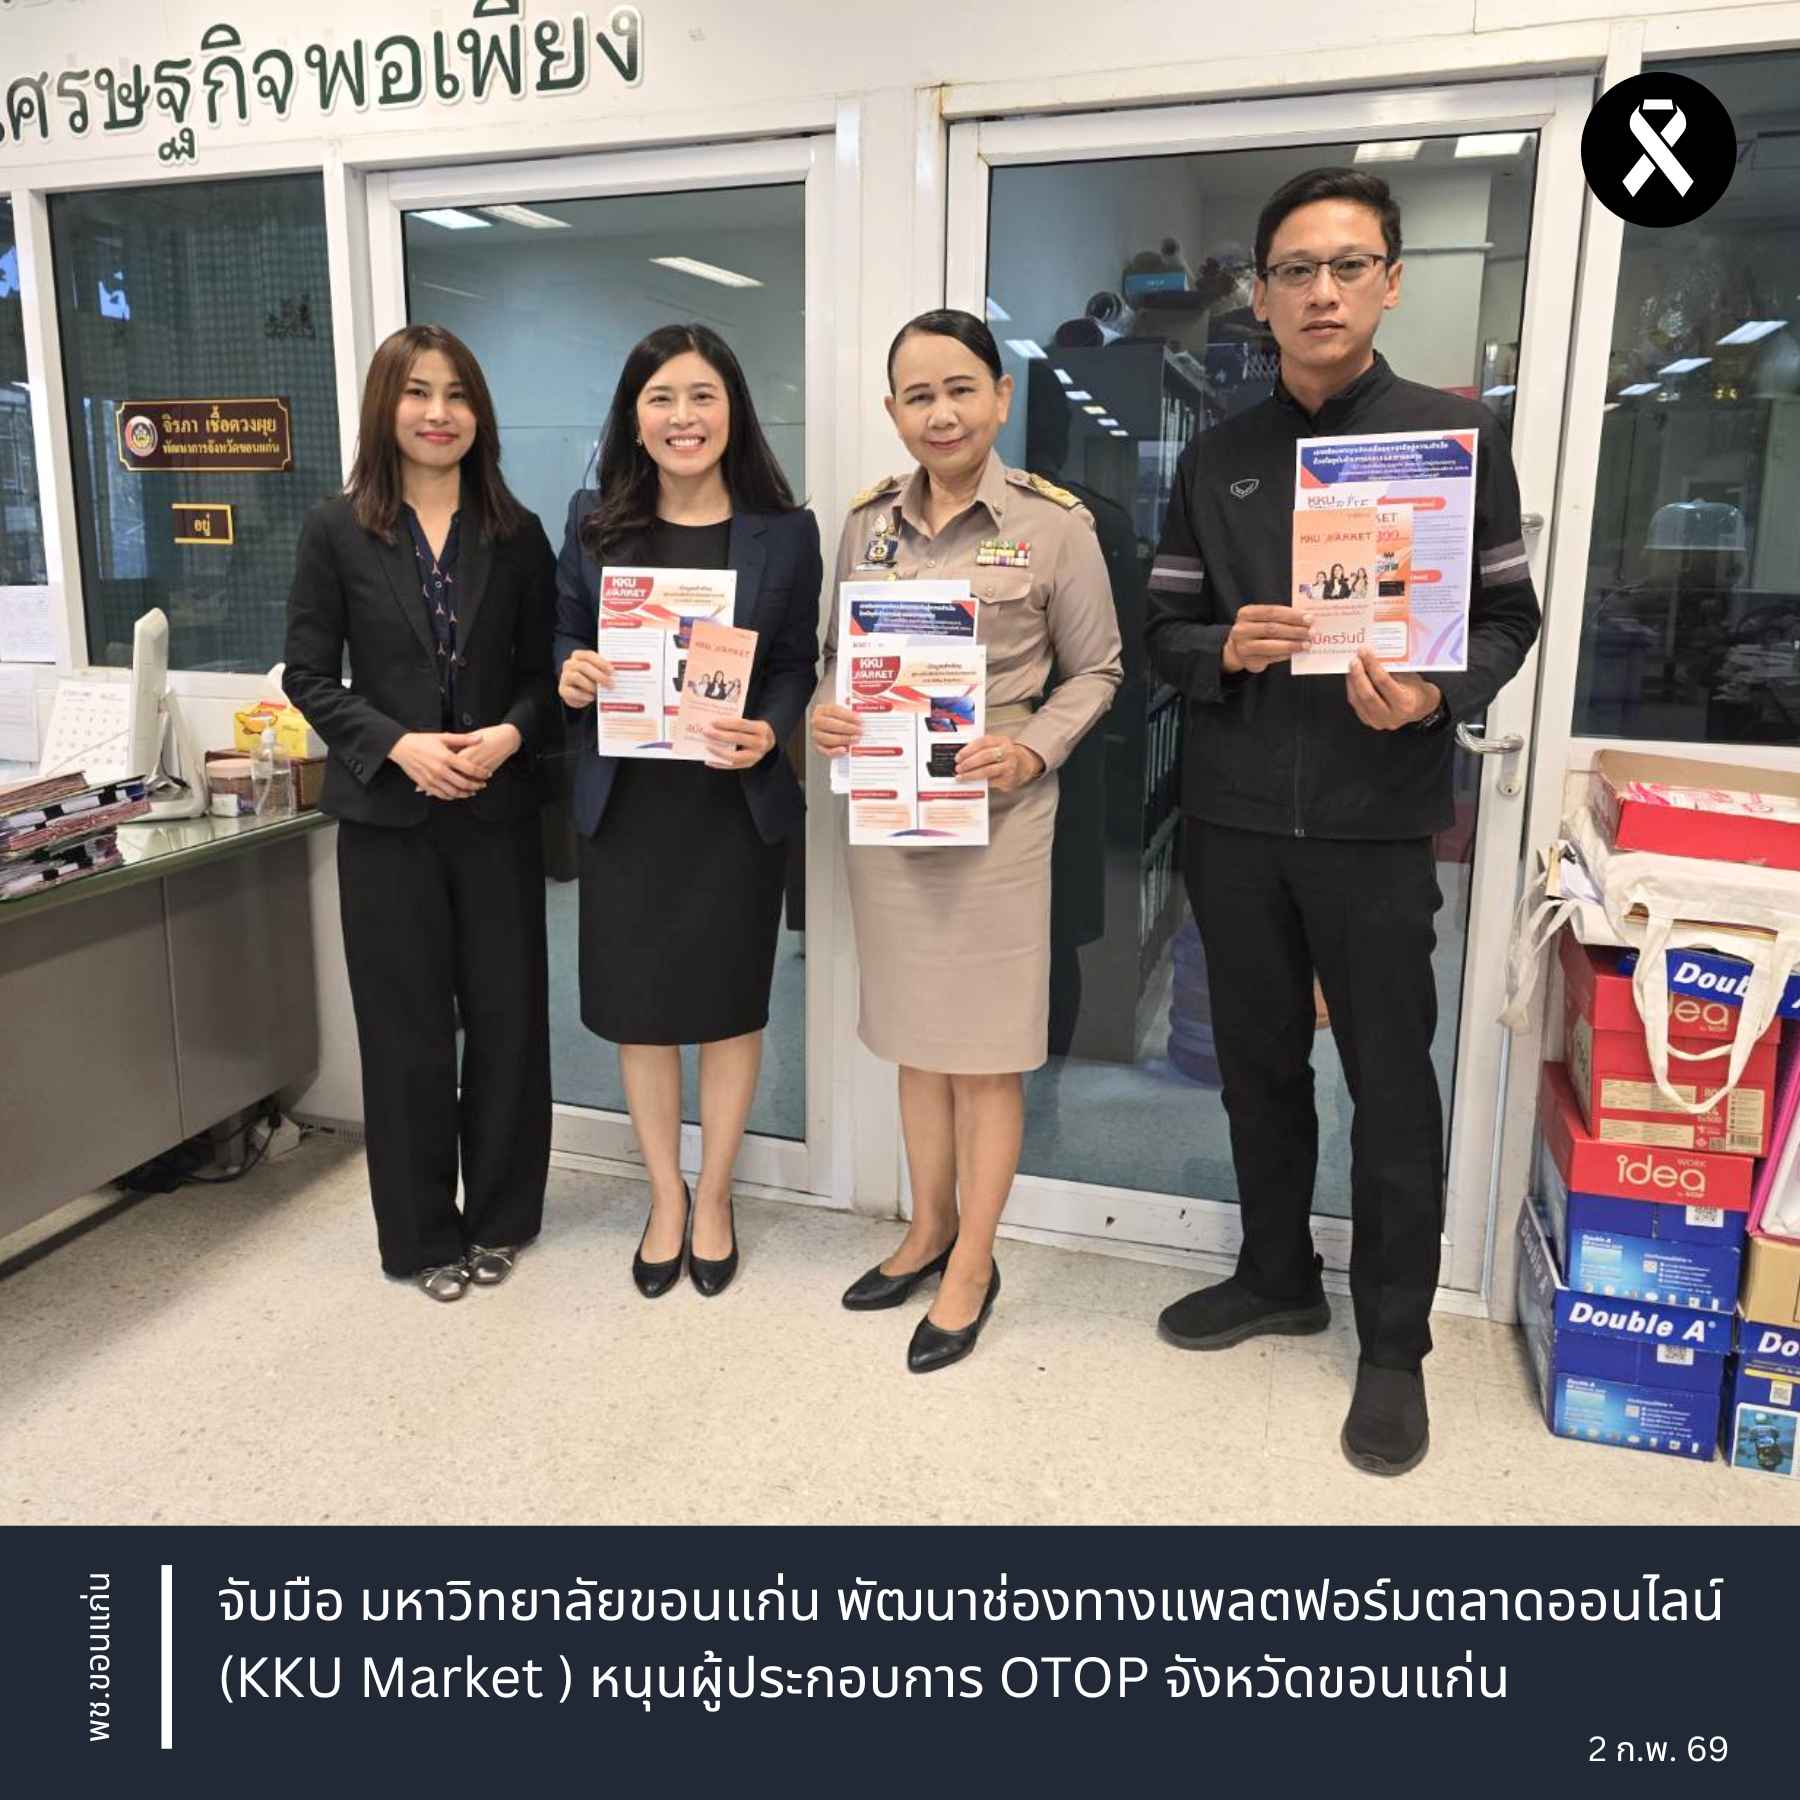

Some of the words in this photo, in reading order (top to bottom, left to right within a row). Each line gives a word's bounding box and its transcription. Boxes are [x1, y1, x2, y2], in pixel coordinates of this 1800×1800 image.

[194, 512, 211, 537] อยู่
[612, 576, 636, 588] KKU
[859, 657, 884, 669] KKU
[853, 669, 894, 679] MARKET
[1616, 1153, 1706, 1193] idea
[1568, 1301, 1674, 1337] Double
